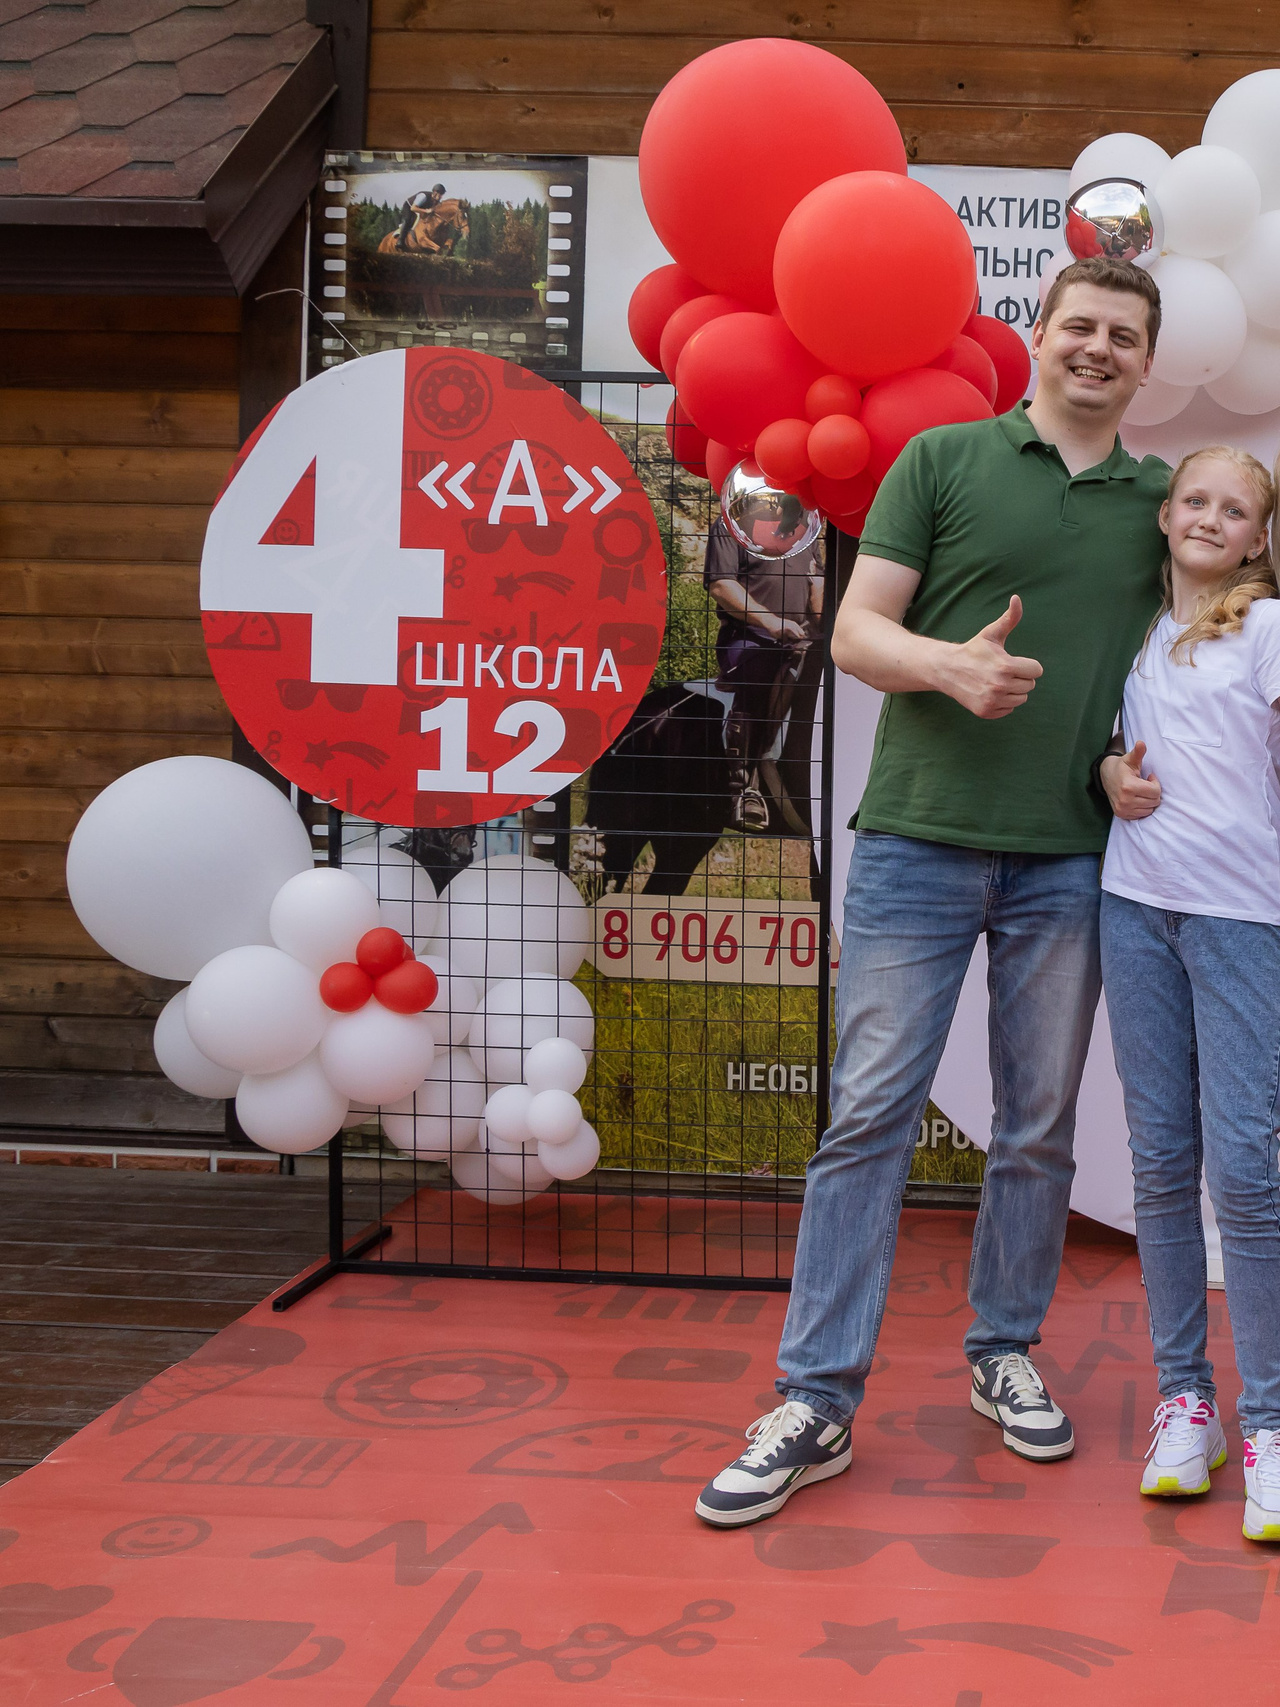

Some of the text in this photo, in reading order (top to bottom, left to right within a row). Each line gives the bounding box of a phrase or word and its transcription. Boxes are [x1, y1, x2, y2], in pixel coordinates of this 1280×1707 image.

[957, 195, 1069, 229] АКТИВ
[200, 348, 445, 686] 4
[414, 641, 623, 693] ШКОЛА
[416, 697, 584, 796] 12
[602, 909, 840, 969] 8 906 70
